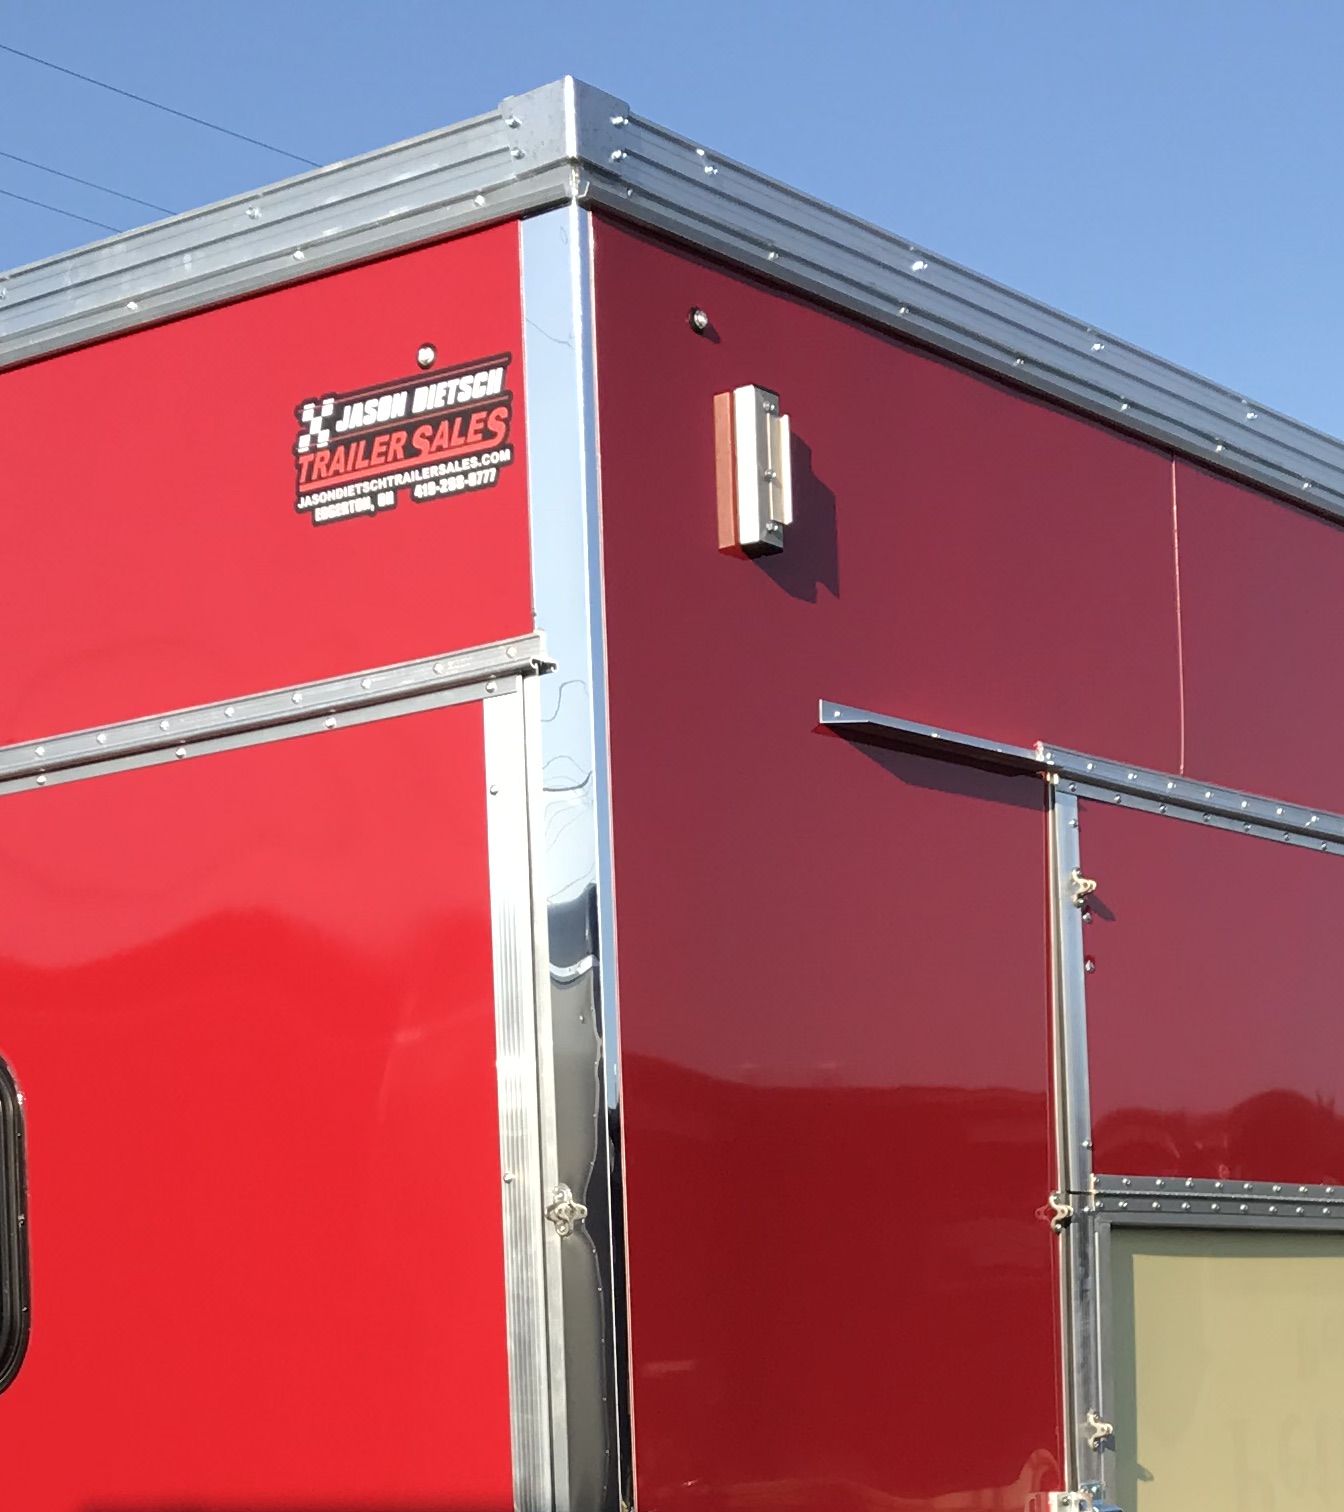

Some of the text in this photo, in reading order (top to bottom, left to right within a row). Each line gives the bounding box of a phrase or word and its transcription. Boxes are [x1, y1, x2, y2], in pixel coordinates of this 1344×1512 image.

[336, 367, 503, 432] JASON DIETSCH
[298, 406, 509, 483] TRAILER SALES
[297, 449, 511, 508] JASONDIETSCHTRAILERSALES.COM
